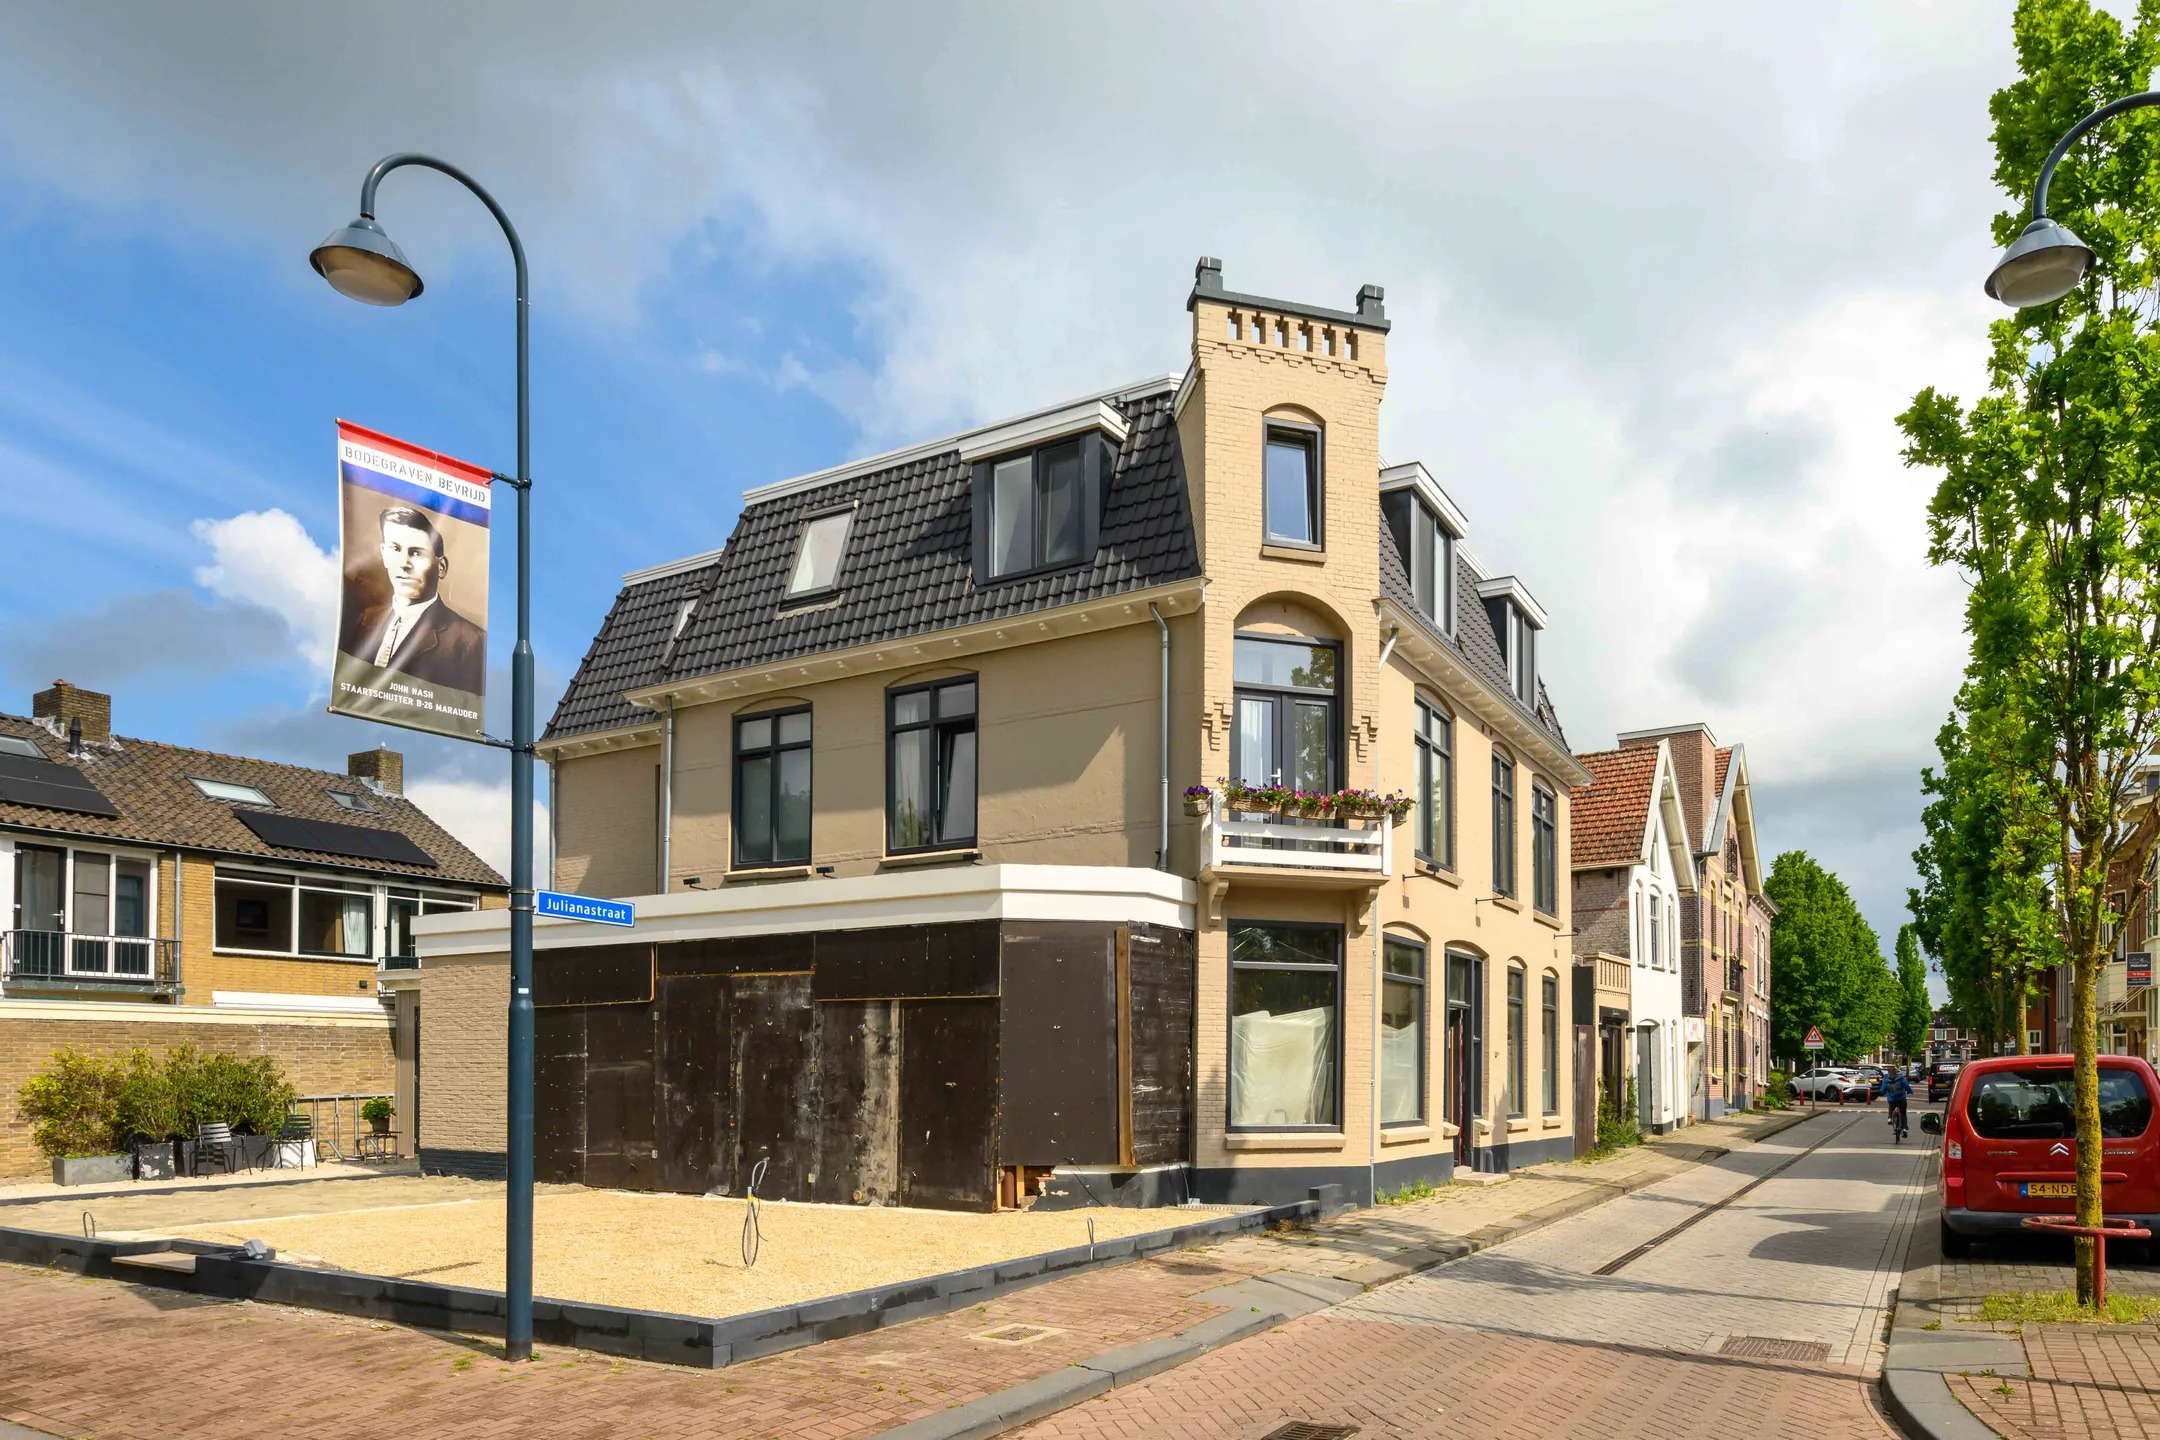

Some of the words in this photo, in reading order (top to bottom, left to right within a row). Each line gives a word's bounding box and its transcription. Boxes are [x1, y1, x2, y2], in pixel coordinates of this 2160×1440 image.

[345, 446, 433, 484] BODEGRAVEN
[438, 477, 486, 502] BEVRIJD
[340, 682, 413, 706] STAARTSCHUTTER
[416, 700, 433, 710] B-26
[435, 703, 478, 720] MARAUDER
[389, 682, 409, 694] JOHN
[412, 687, 434, 699] NASH
[546, 898, 626, 920] Julianastraat
